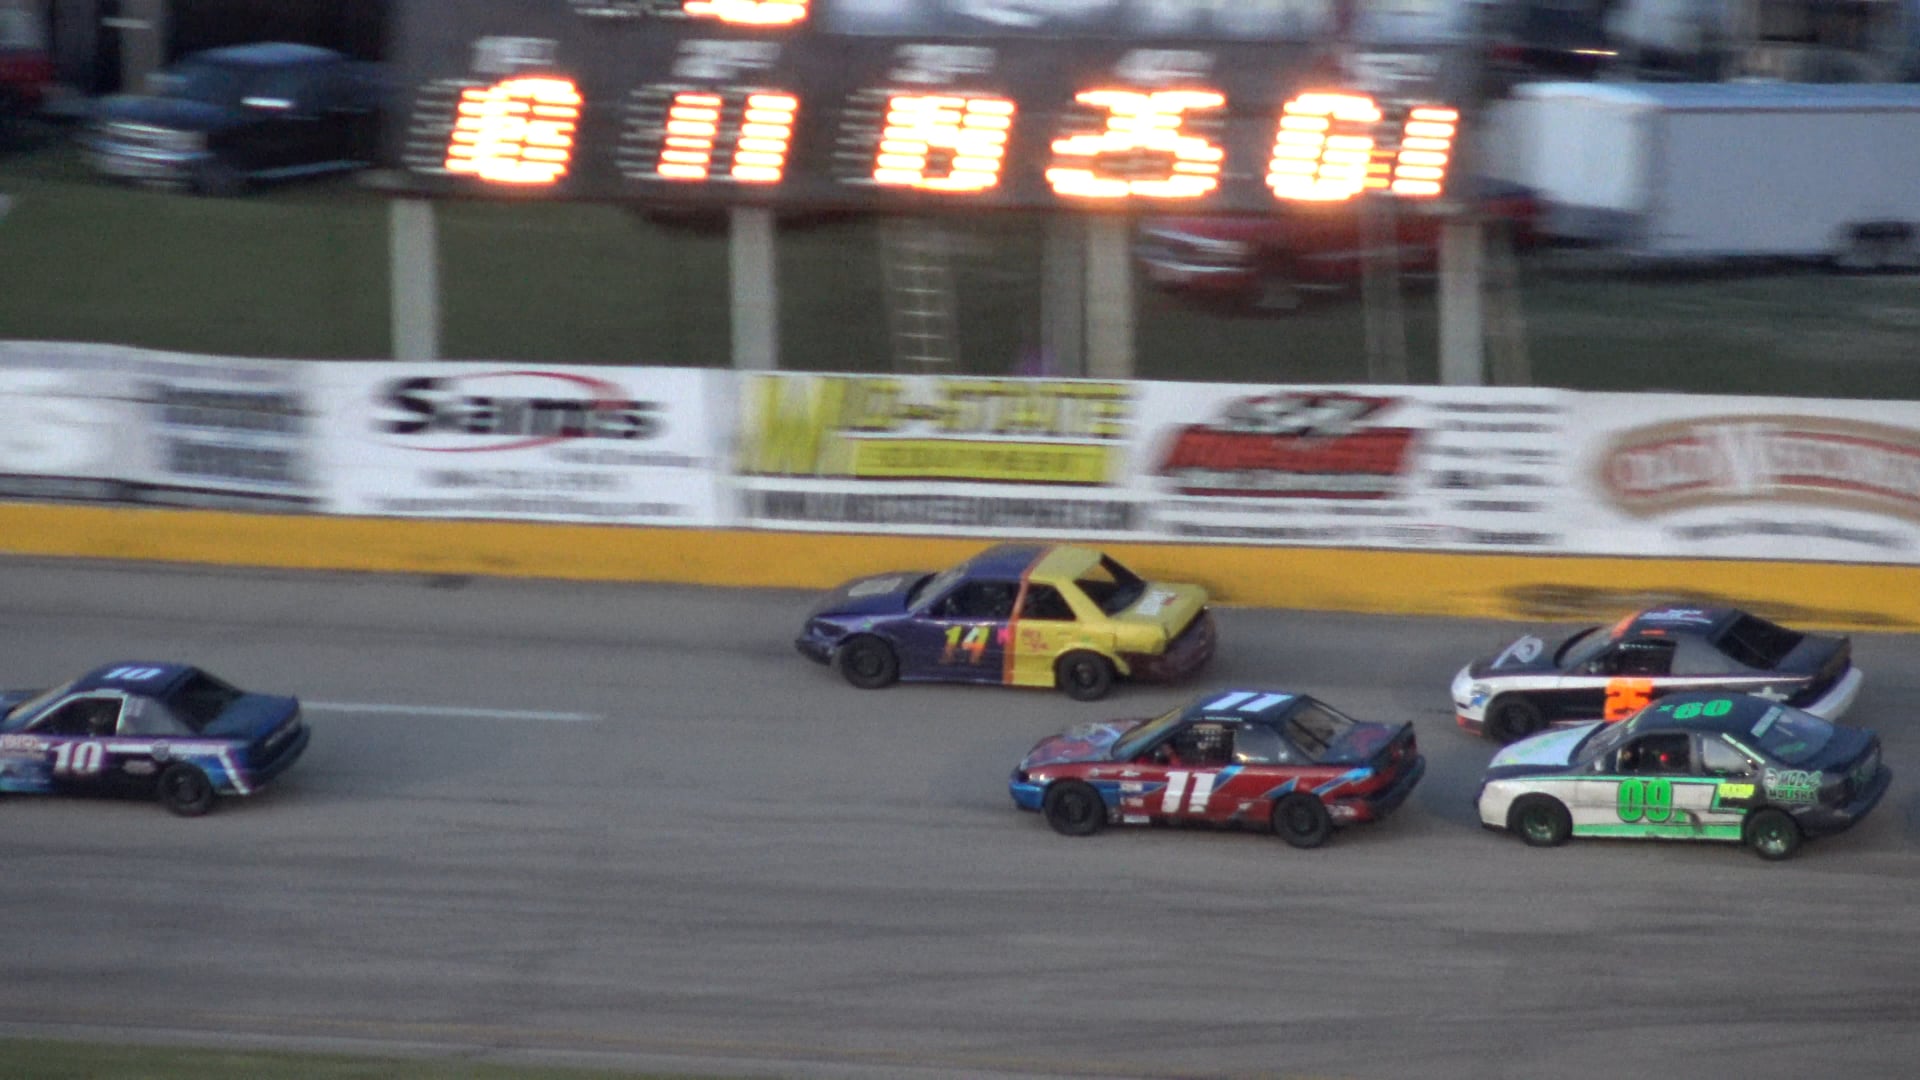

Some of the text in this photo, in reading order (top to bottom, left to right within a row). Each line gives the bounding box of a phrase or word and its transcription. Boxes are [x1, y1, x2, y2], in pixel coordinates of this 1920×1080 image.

[944, 624, 990, 665] 14
[1202, 692, 1294, 713] 11
[50, 741, 103, 774] 10
[1161, 771, 1217, 813] 11
[1617, 777, 1673, 823] 09
